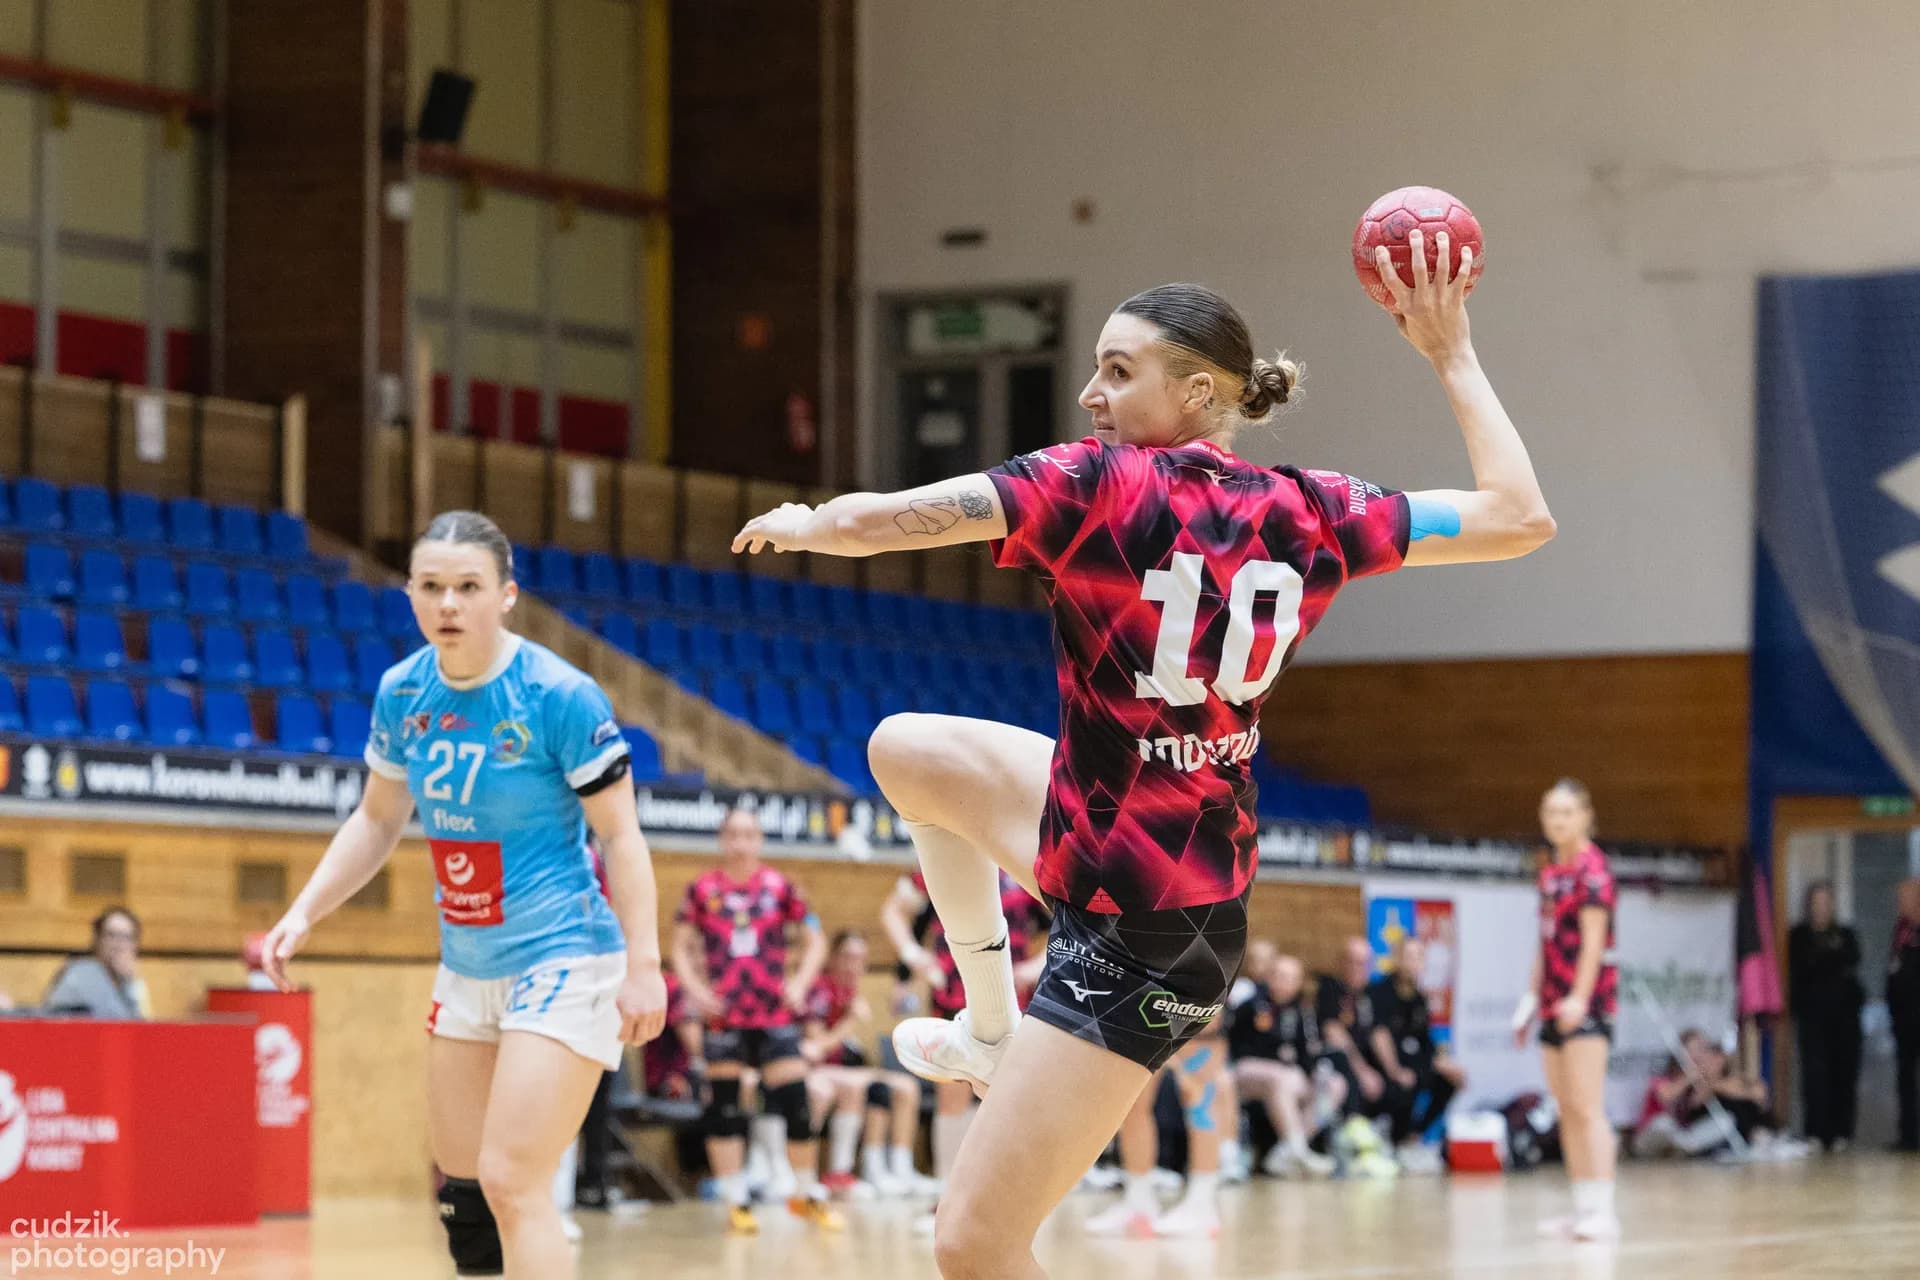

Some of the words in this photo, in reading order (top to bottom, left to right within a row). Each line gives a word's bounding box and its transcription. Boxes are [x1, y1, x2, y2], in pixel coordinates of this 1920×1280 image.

[1135, 551, 1304, 706] 10
[424, 740, 487, 806] 27
[433, 808, 477, 833] flex
